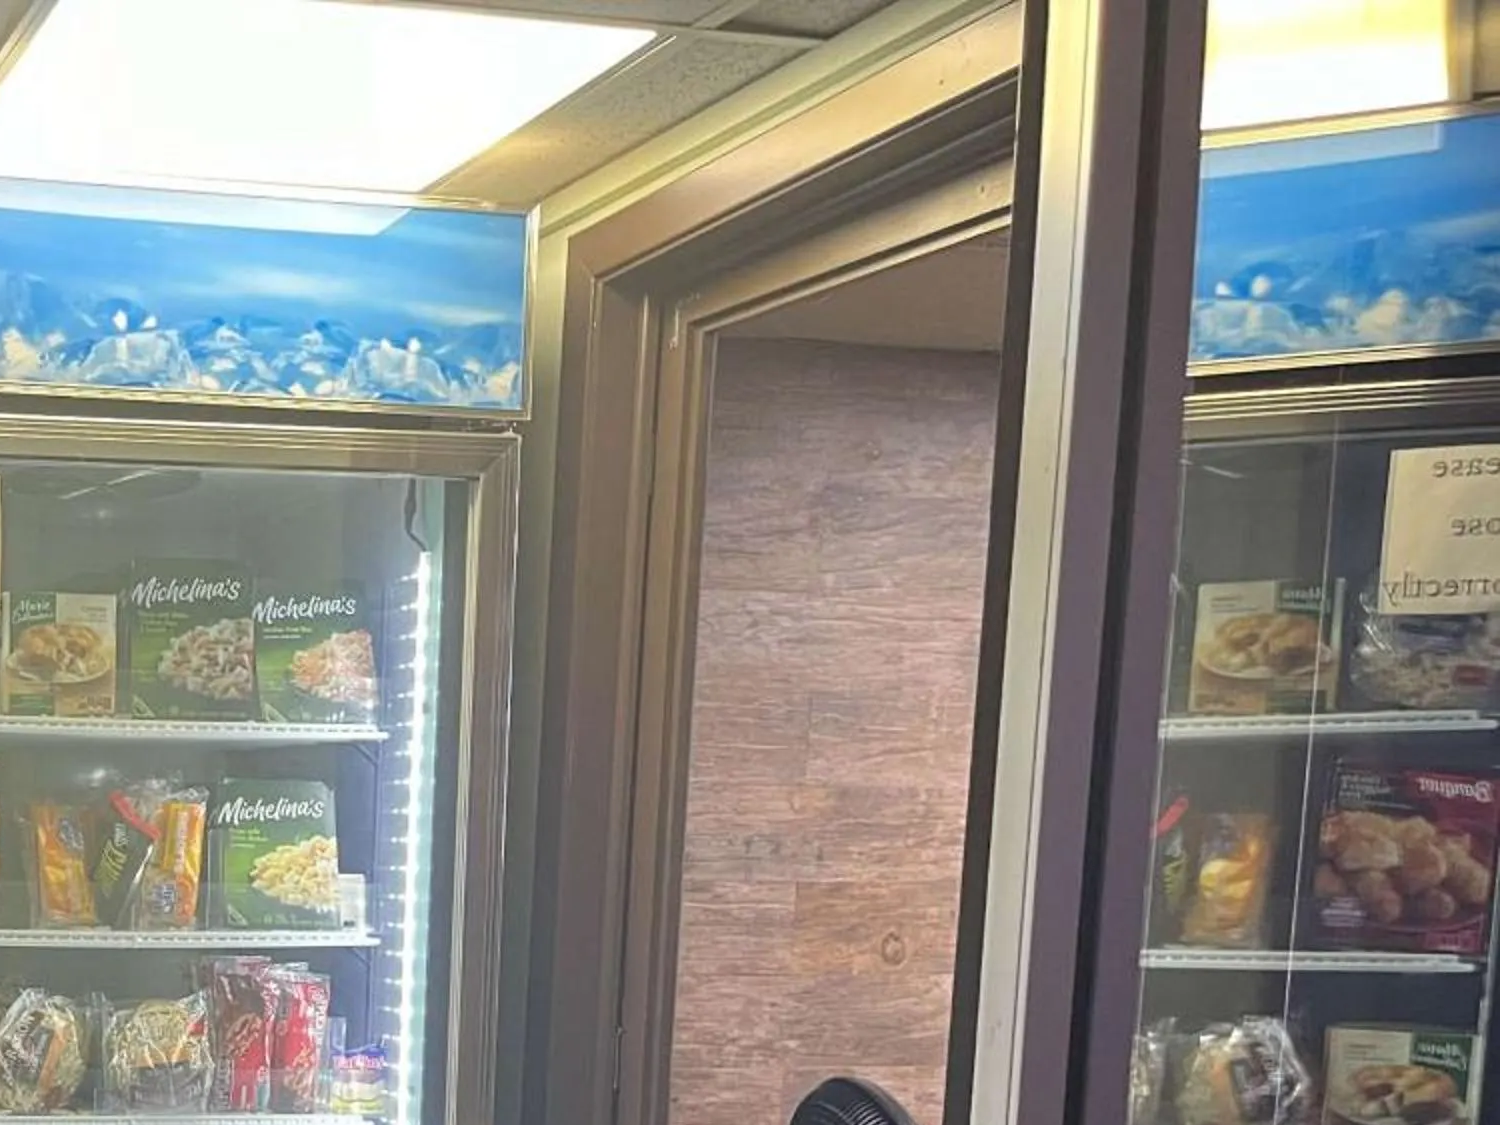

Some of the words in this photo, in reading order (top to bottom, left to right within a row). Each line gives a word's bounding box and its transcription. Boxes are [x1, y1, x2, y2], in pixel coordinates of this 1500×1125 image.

[131, 576, 241, 608] Michelina's
[252, 596, 357, 624] Michelina's
[217, 796, 326, 825] Michelina's
